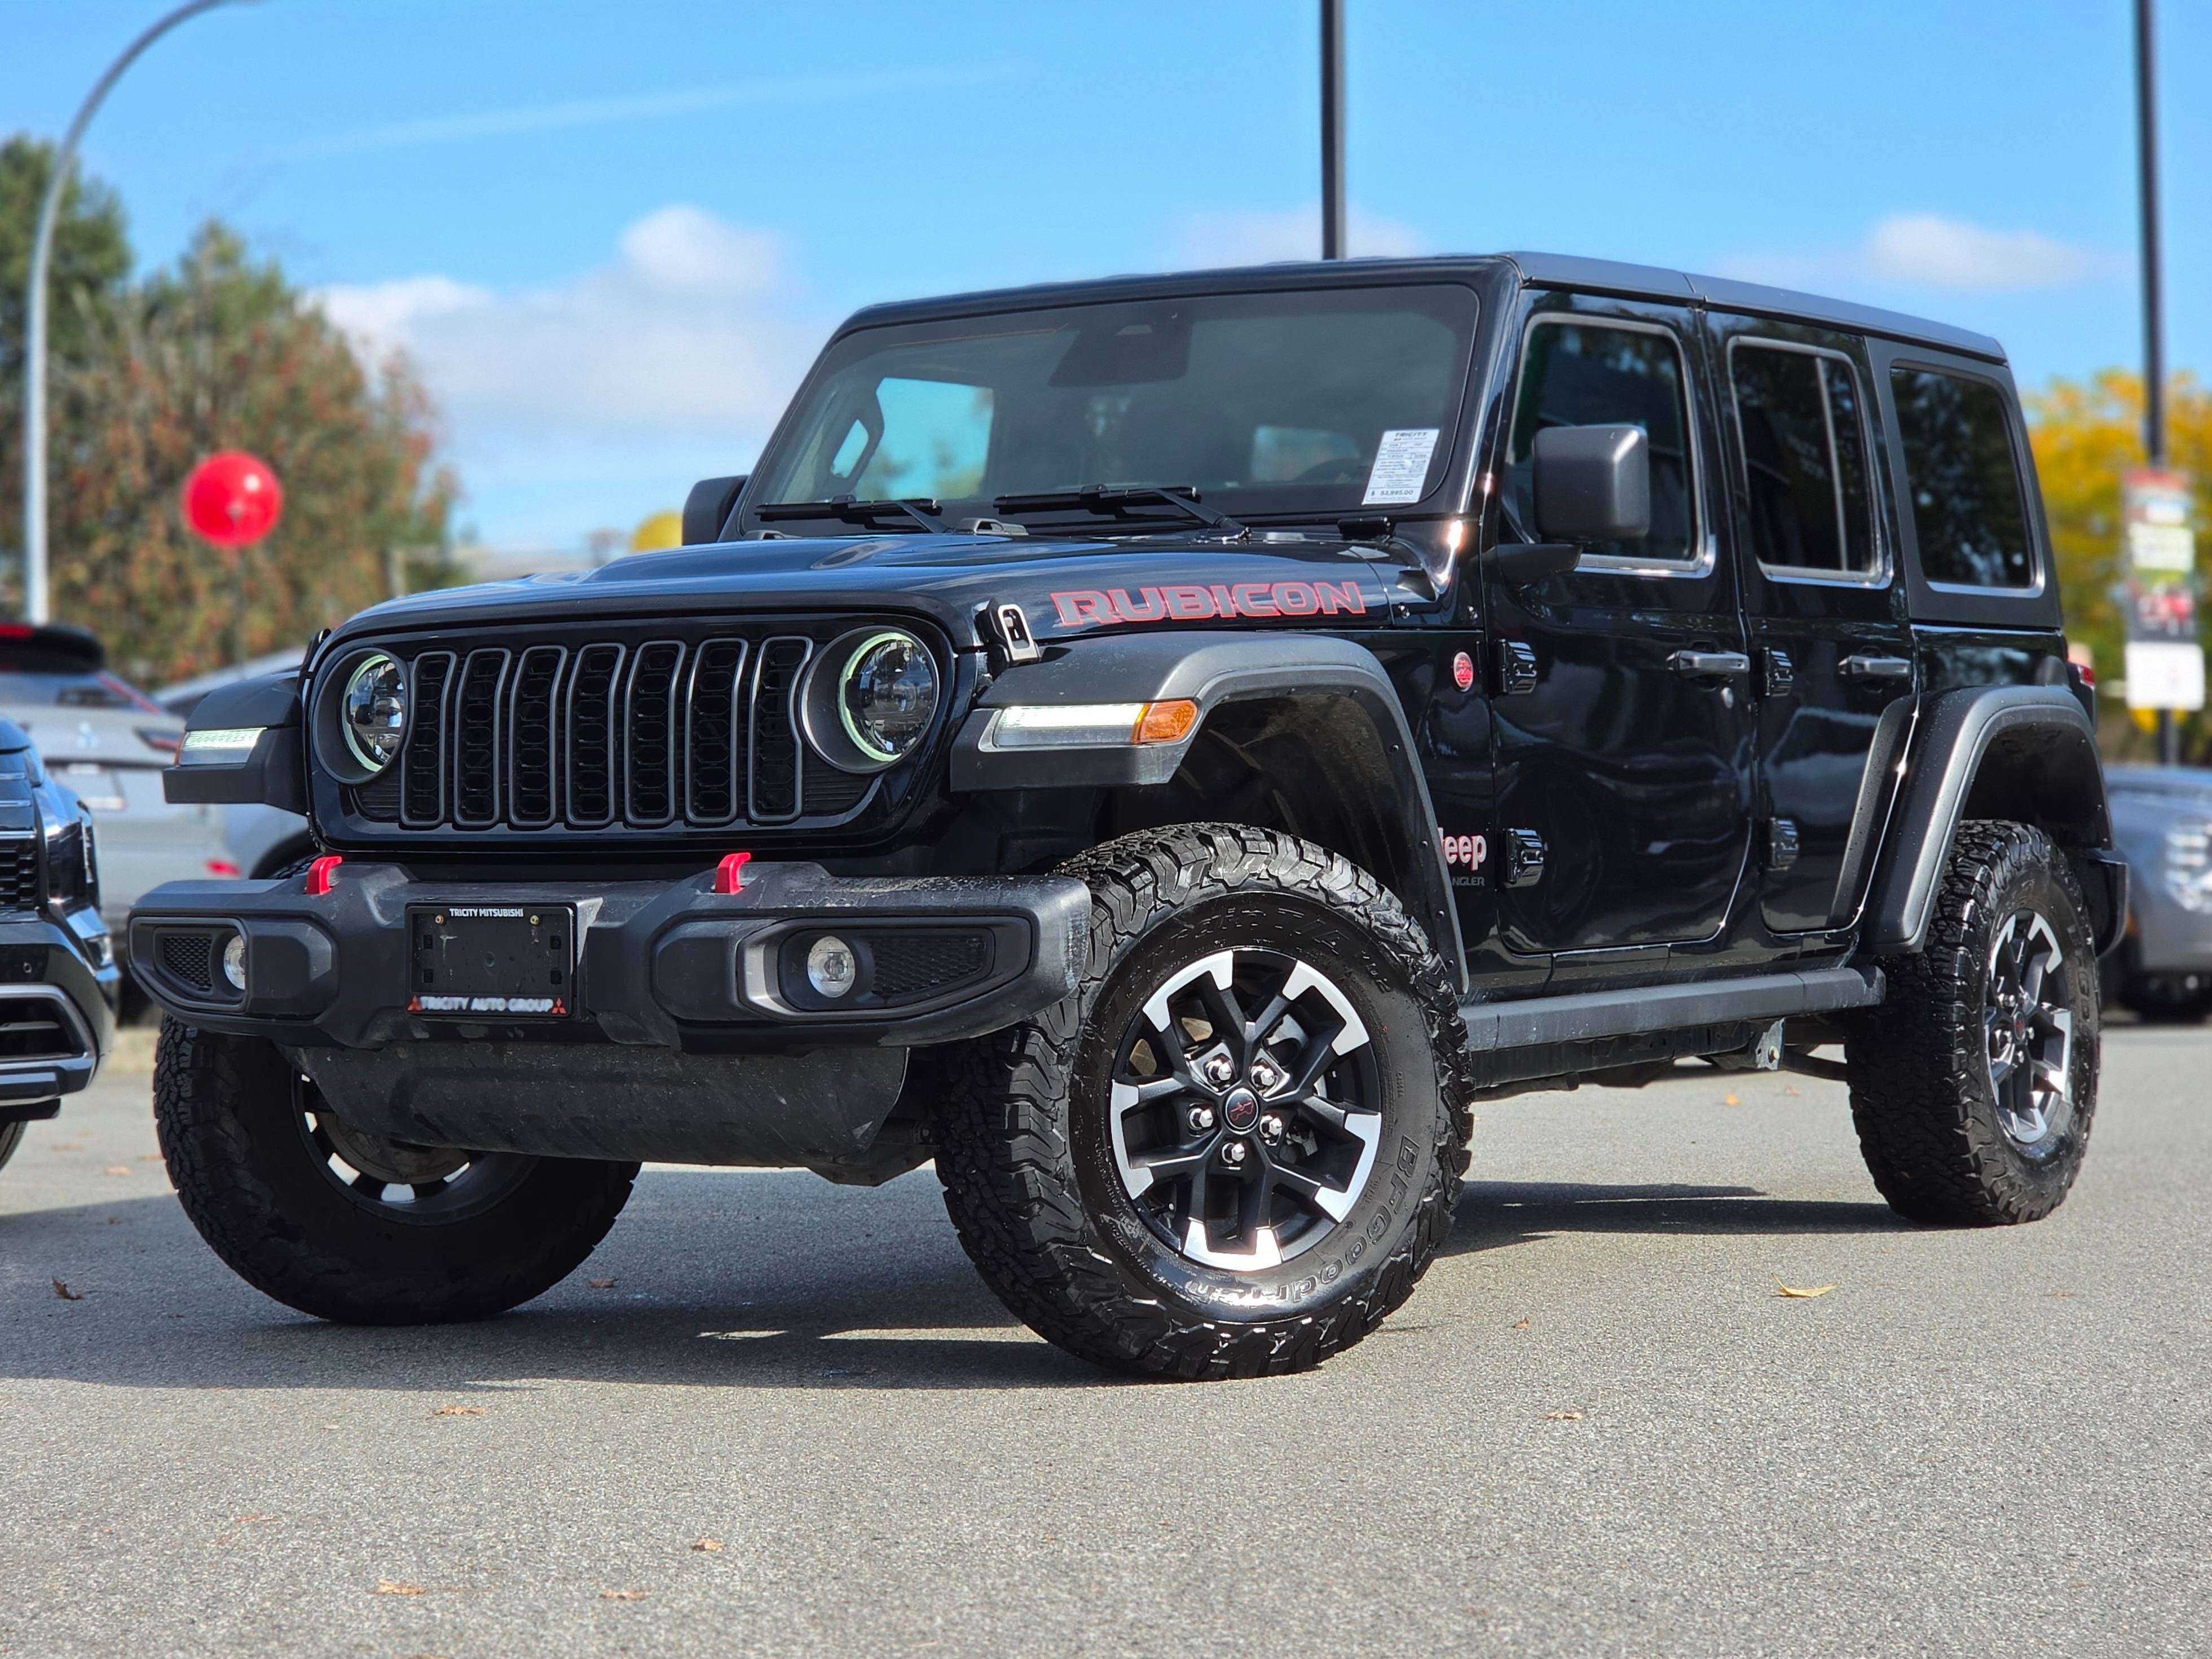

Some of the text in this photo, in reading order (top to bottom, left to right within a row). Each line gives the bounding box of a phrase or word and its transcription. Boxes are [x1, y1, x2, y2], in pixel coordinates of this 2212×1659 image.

[1050, 581, 1366, 626] RUBICON
[1451, 877, 1484, 886] NGLER
[449, 908, 523, 917] TRICITY MITSUBISHI
[470, 997, 506, 1011] AUTO
[508, 998, 554, 1012] GROUP
